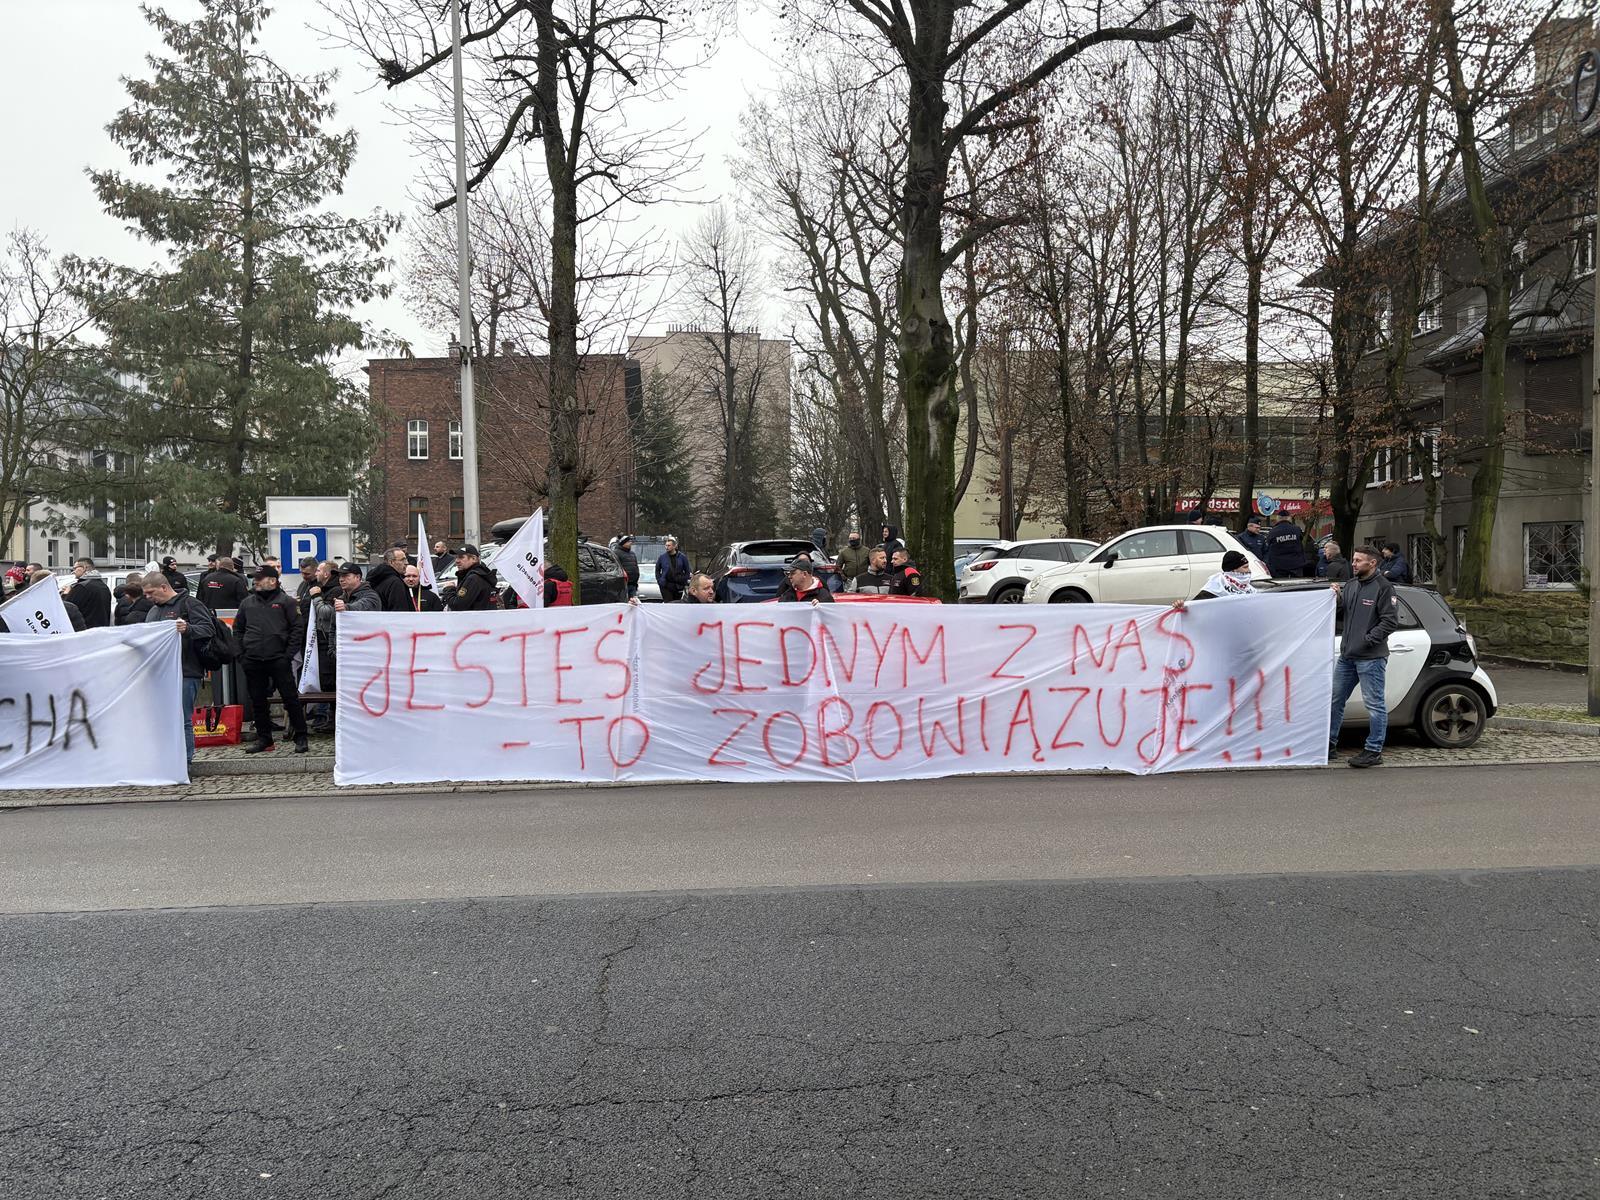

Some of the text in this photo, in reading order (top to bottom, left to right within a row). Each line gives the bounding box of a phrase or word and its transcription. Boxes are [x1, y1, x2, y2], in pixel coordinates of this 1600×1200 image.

[1181, 499, 1240, 512] przdszko
[291, 533, 318, 570] P
[1276, 534, 1297, 543] POLICJA
[353, 608, 1195, 717] JESTEŚ JEDNYM Z NAS
[559, 715, 650, 770] TO
